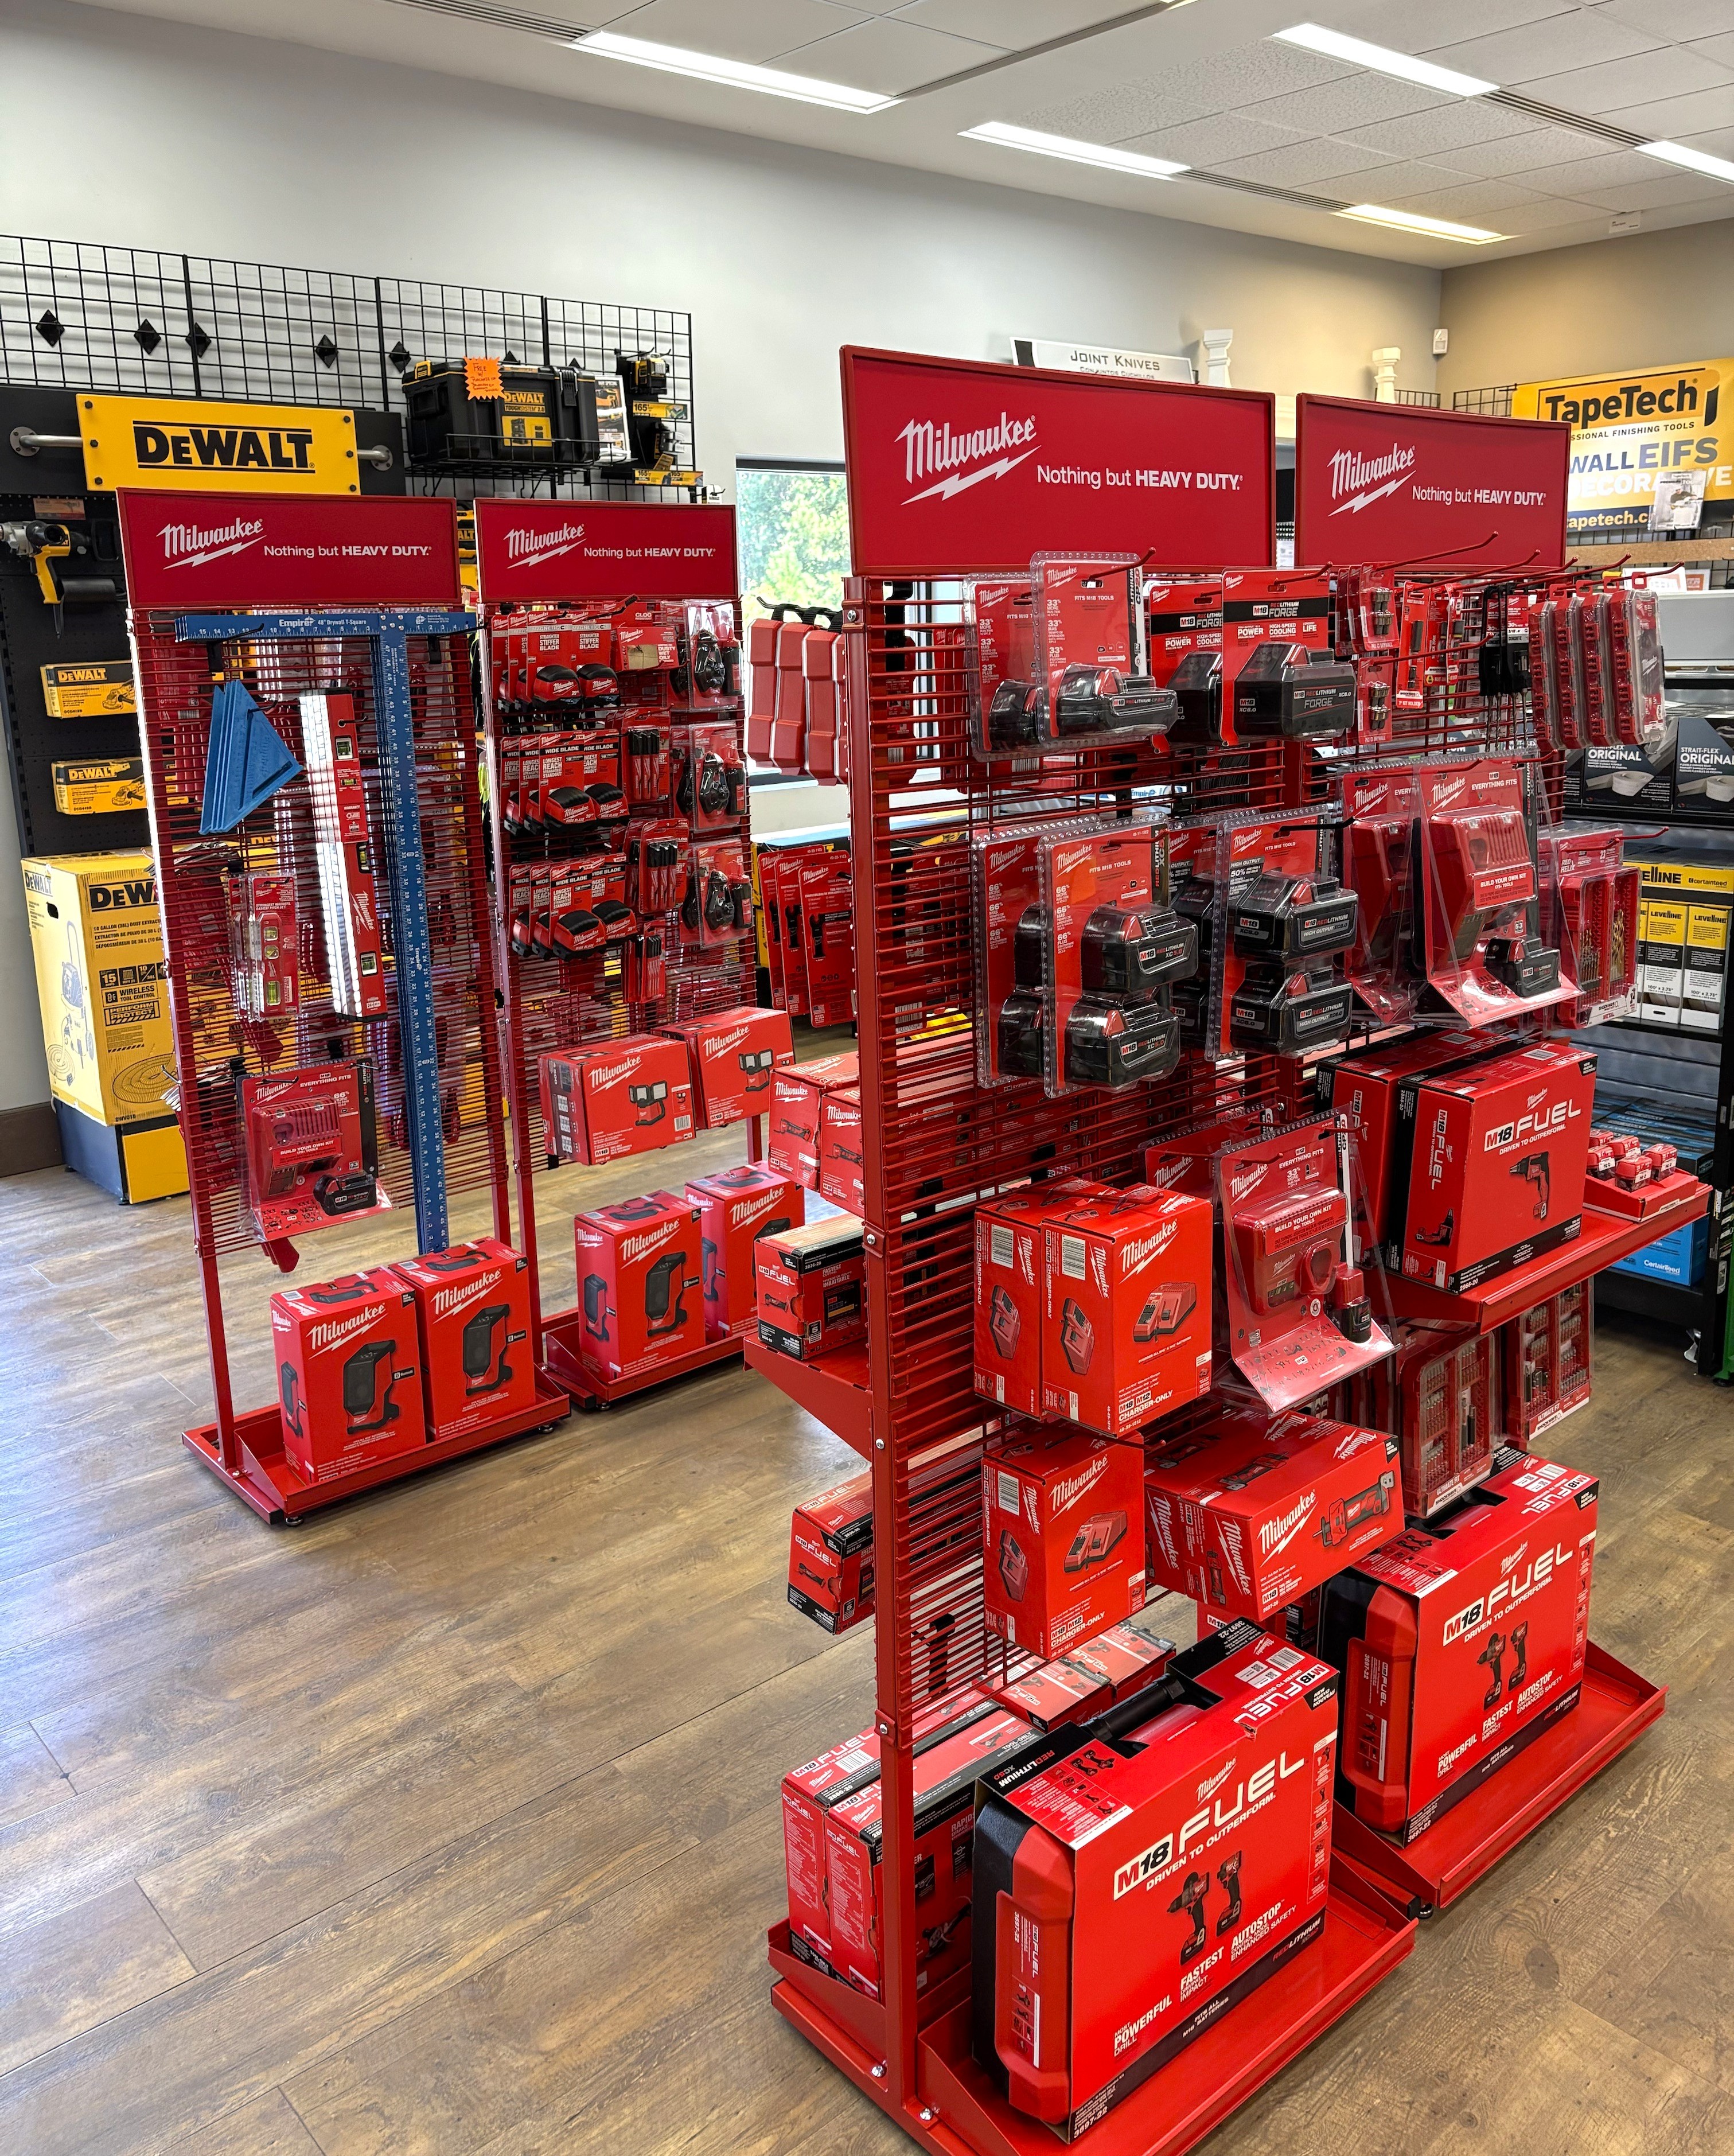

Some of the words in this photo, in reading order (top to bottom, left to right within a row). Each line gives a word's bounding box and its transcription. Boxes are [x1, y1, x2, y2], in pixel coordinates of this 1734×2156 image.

[1071, 351, 1108, 365] JOINT
[1115, 355, 1160, 371] KNIVES
[1080, 367, 1119, 375] CONUNTOS
[504, 392, 544, 403] DEWALT
[1546, 379, 1697, 430] TapeTech
[1612, 426, 1660, 436] FINISHING
[1663, 422, 1694, 430] TOOLS
[134, 426, 313, 468] DEWALT
[895, 411, 1036, 483] Milwaukee
[1038, 465, 1101, 490] Nothing
[1106, 469, 1132, 487] but
[1136, 470, 1191, 489] HEAVY
[1639, 437, 1719, 469] EIFS
[1327, 443, 1416, 499] Milwaukee
[1413, 485, 1452, 506] Nothing
[1455, 488, 1471, 503] but
[1474, 490, 1511, 504] HEAVY
[157, 517, 263, 558] Milwaukee
[264, 546, 316, 560] Nothing
[318, 546, 339, 556] but
[342, 546, 388, 556] HEAVY
[504, 523, 585, 559] Milwaukee
[584, 548, 623, 559] Nothing
[626, 548, 642, 557] but
[645, 548, 681, 556] HEAVY
[1047, 566, 1077, 583] Milwaukee
[978, 587, 1009, 604] Milwaukee
[1269, 607, 1298, 617] FORGE
[1166, 638, 1191, 647] POWER
[1238, 628, 1264, 636] POWER
[58, 670, 107, 682] DEWALT
[1304, 697, 1332, 709] FORGE
[1588, 749, 1642, 761] ORIGINAL
[1354, 783, 1388, 809] Milwaukee
[1431, 777, 1466, 806] Milwaukee
[1472, 780, 1504, 790] EVERYTHING
[1233, 828, 1262, 849] Milwaukee
[989, 844, 1026, 870] Milwaukee
[1057, 844, 1092, 871] Milwaukee
[91, 882, 158, 909] DEW
[355, 890, 375, 931] Milwaukee
[102, 974, 116, 983] 15
[119, 986, 154, 997] WIRELESS
[110, 1002, 153, 1013] PERFORM
[1237, 1009, 1253, 1017] M18
[703, 1025, 750, 1057] Milwaukee
[300, 1078, 337, 1088] EVERYTHING
[588, 1055, 642, 1088] Milwaukee
[774, 1080, 809, 1099] Milwaukee
[1487, 1126, 1513, 1149] M18
[1517, 1099, 1581, 1139] FUEL
[1279, 1153, 1311, 1169] EVERYTHING
[1312, 1148, 1324, 1157] FITS
[1229, 1163, 1268, 1197] Milwaukee
[730, 1185, 785, 1225] Milwaukee
[1275, 1222, 1292, 1233] BUILD
[1293, 1215, 1308, 1228] YOUR
[1310, 1209, 1322, 1223] OWN
[1323, 1204, 1332, 1213] KIT
[619, 1219, 681, 1260] Milwaukee
[1119, 1219, 1178, 1272] Milwaukee
[770, 1271, 795, 1286] FUEL
[1094, 1245, 1109, 1299] Milwaukee
[1644, 1259, 1680, 1275] CertainTeed
[430, 1268, 501, 1316] Milwaukee
[306, 1302, 386, 1351] Milwaukee
[1119, 1389, 1173, 1421] CHARGER-ONLY
[1050, 1453, 1108, 1504] Milwaukee
[1257, 1489, 1317, 1554] Milwaukee
[1222, 1518, 1252, 1597] Milwaukee
[1447, 1602, 1482, 1639] M18
[1487, 1542, 1573, 1616] FUEL
[1050, 1611, 1106, 1648] CHARGER-ONLY
[1300, 1667, 1326, 1684] M18
[1233, 1681, 1303, 1722] FUEL
[1482, 1700, 1513, 1732] FASTEST
[795, 1762, 817, 1776] M18
[818, 1733, 874, 1764] FUEL
[1437, 1734, 1477, 1770] POWERFUL
[1197, 1757, 1237, 1801] Milwaukee
[1118, 1841, 1170, 1895] M18
[1179, 1751, 1305, 1855] FUEL
[1146, 1855, 1187, 1891] DRIVEN
[1189, 1844, 1203, 1859] TO
[1231, 1927, 1269, 1962] ENHANCED
[1271, 1905, 1296, 1929] SAFETY
[1232, 1902, 1281, 1949] AUTOSTOP
[1180, 1946, 1224, 1989] FASTEST
[1115, 1994, 1172, 2049] POWERFUL
